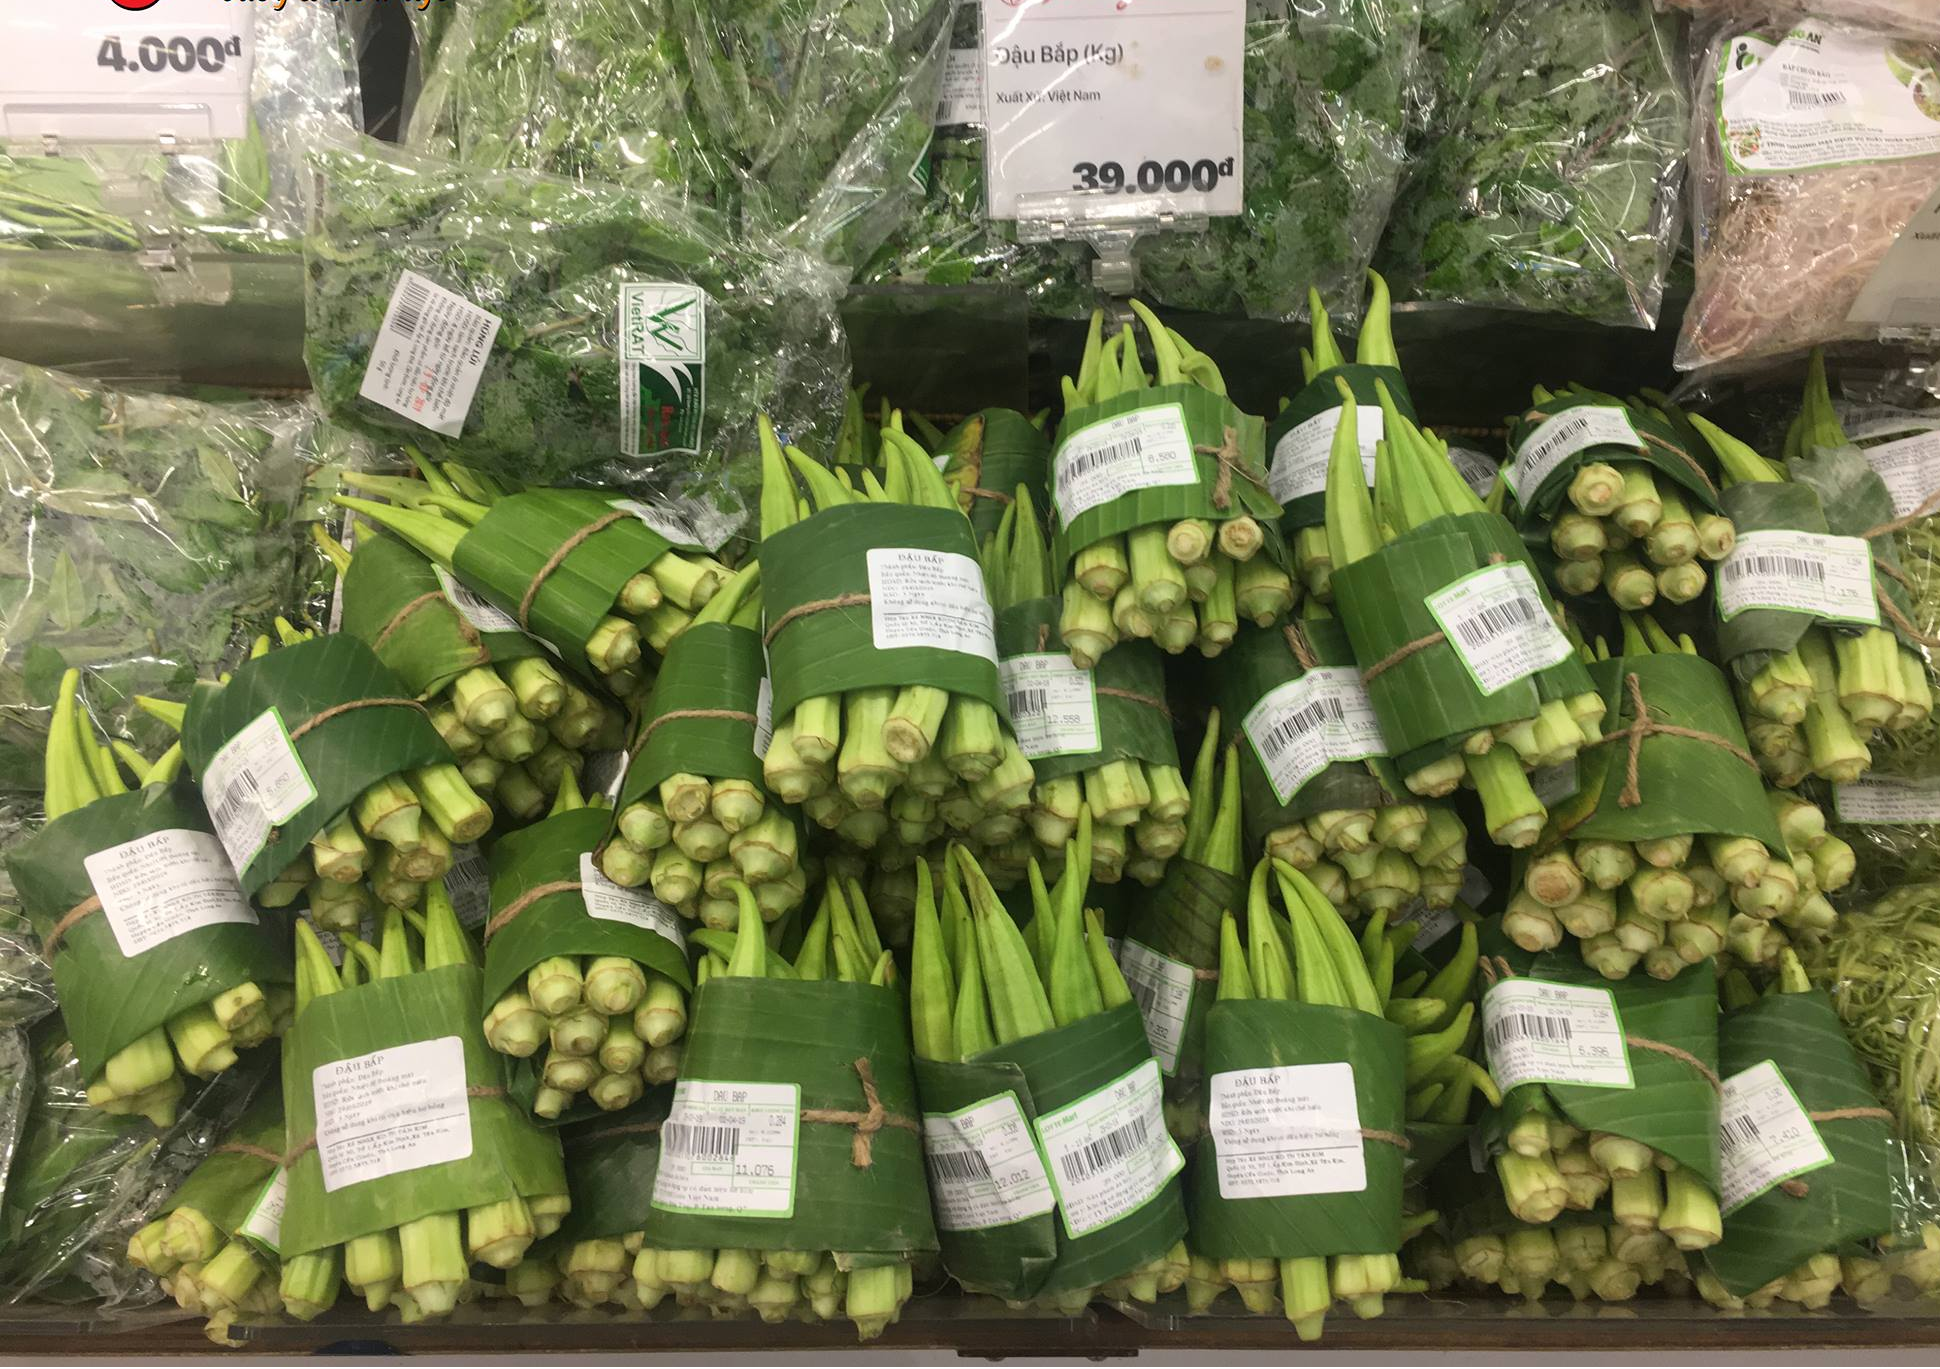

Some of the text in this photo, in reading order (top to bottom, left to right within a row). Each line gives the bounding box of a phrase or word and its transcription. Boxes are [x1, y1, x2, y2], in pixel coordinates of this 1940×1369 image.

[1041, 41, 1079, 67] Bắp
[1084, 42, 1124, 67] (Kg)
[996, 90, 1023, 104] Xuất
[1047, 89, 1071, 104] Việt
[1073, 90, 1101, 102] Nam
[1072, 157, 1234, 194] 39.000đ
[475, 319, 492, 350] HÚNG
[631, 292, 646, 355] VietRAT
[995, 1168, 1031, 1191] 12.012
